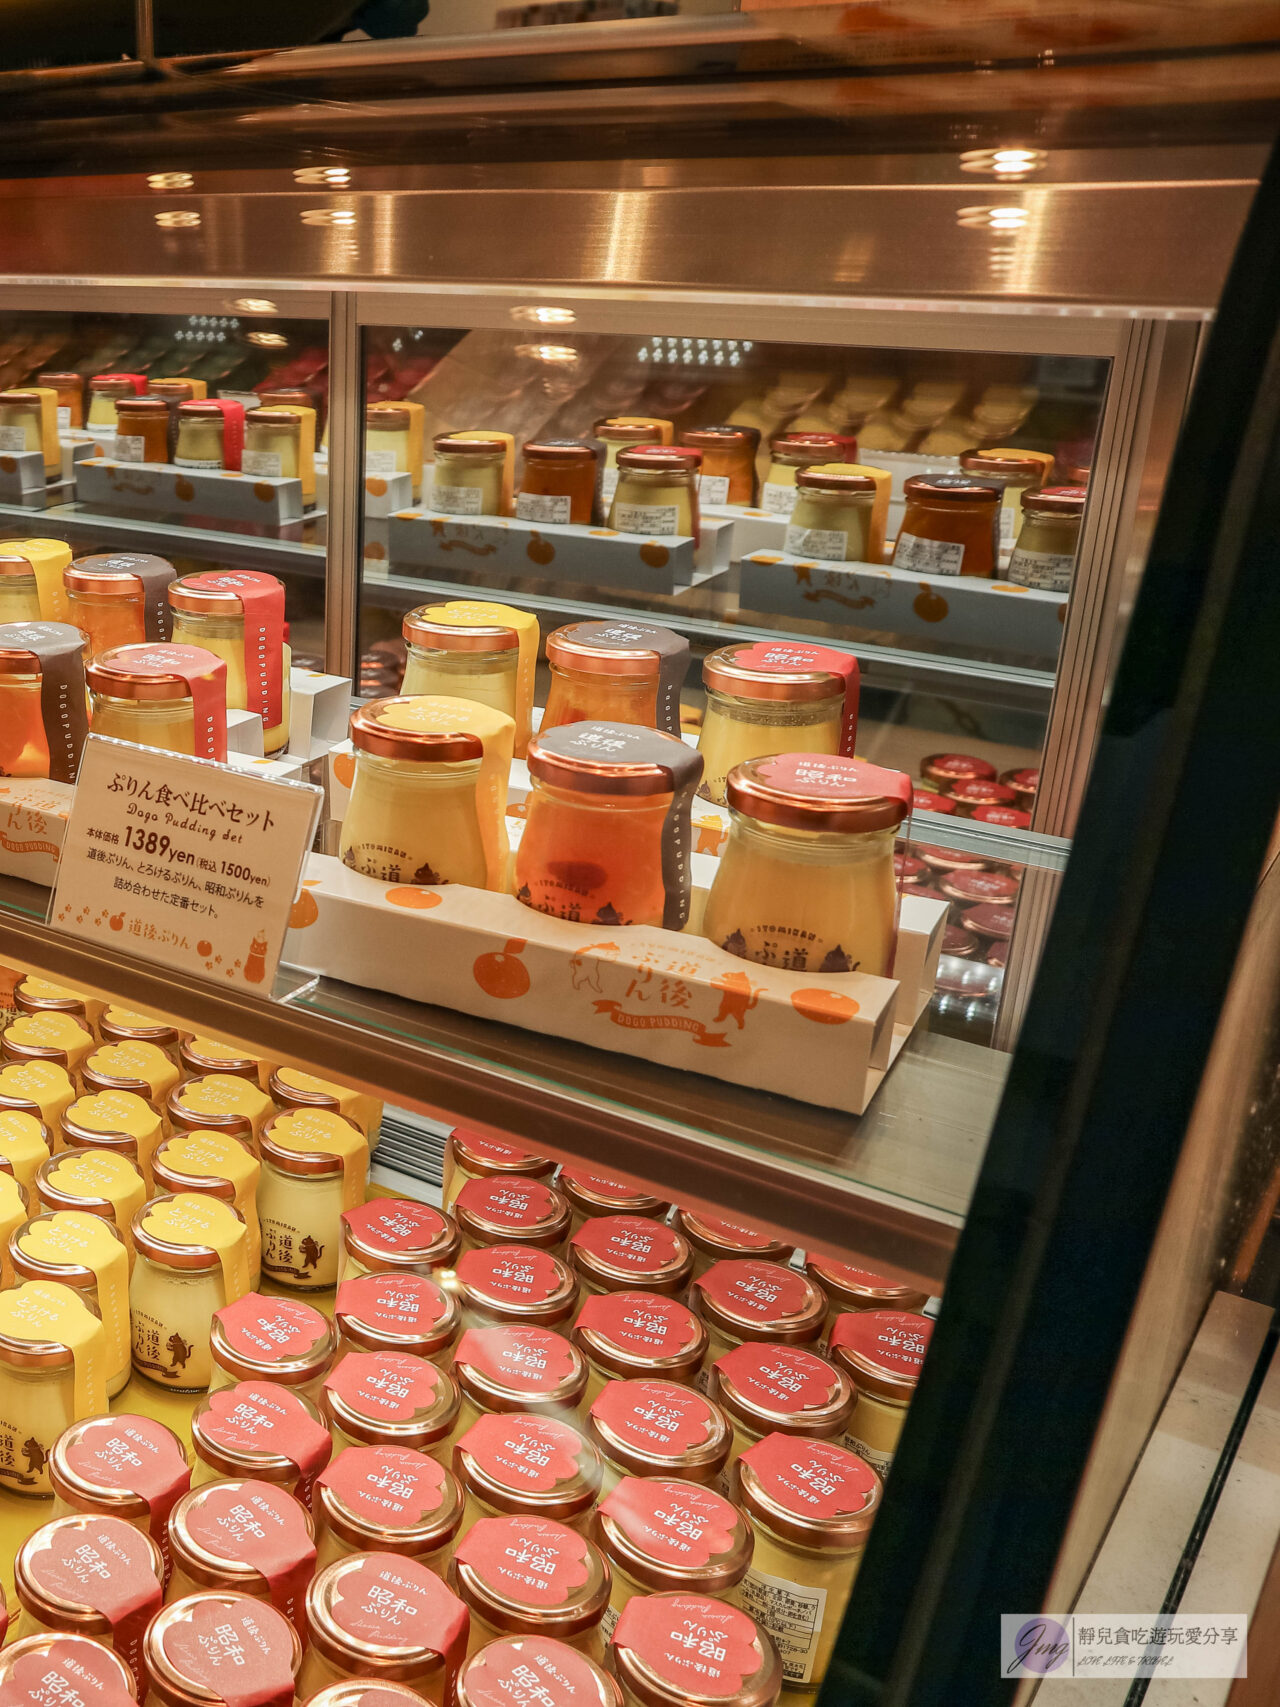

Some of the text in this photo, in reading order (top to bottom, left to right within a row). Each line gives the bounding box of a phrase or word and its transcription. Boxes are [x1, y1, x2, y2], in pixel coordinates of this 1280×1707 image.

[764, 652, 814, 663] 昭和
[60, 684, 76, 779] DOGOPUDDIN
[795, 769, 857, 782] 昭和
[107, 773, 274, 832] ぷりん食べ比べセット
[87, 827, 119, 845] 本体価格
[165, 813, 216, 841] Pudding
[114, 876, 219, 919] 詰め合わせた定番セット。
[128, 918, 190, 950] 道後ぷりん
[618, 1013, 700, 1032] DOGO PUDDING
[378, 1215, 412, 1237] 昭和
[265, 1229, 276, 1259] ぷりん
[279, 1235, 292, 1263] 道後
[147, 1329, 160, 1361] 道後
[256, 1317, 291, 1344] 昭和
[877, 1335, 925, 1353] 昭和
[234, 1403, 275, 1430] 昭和
[634, 1406, 681, 1432] 昭和
[790, 1462, 836, 1496] 昭和
[505, 1547, 556, 1575] 昭和
[367, 1585, 418, 1617] 昭和
[214, 1623, 246, 1666] 昭和
[670, 1631, 726, 1662] 昭和
[62, 1657, 104, 1690] 道後ぷりん
[512, 1665, 555, 1707] 昭和
[533, 1654, 576, 1694] 道後ぷりん
[28, 1688, 62, 1707] ぷり
[41, 1671, 85, 1707] 昭和
